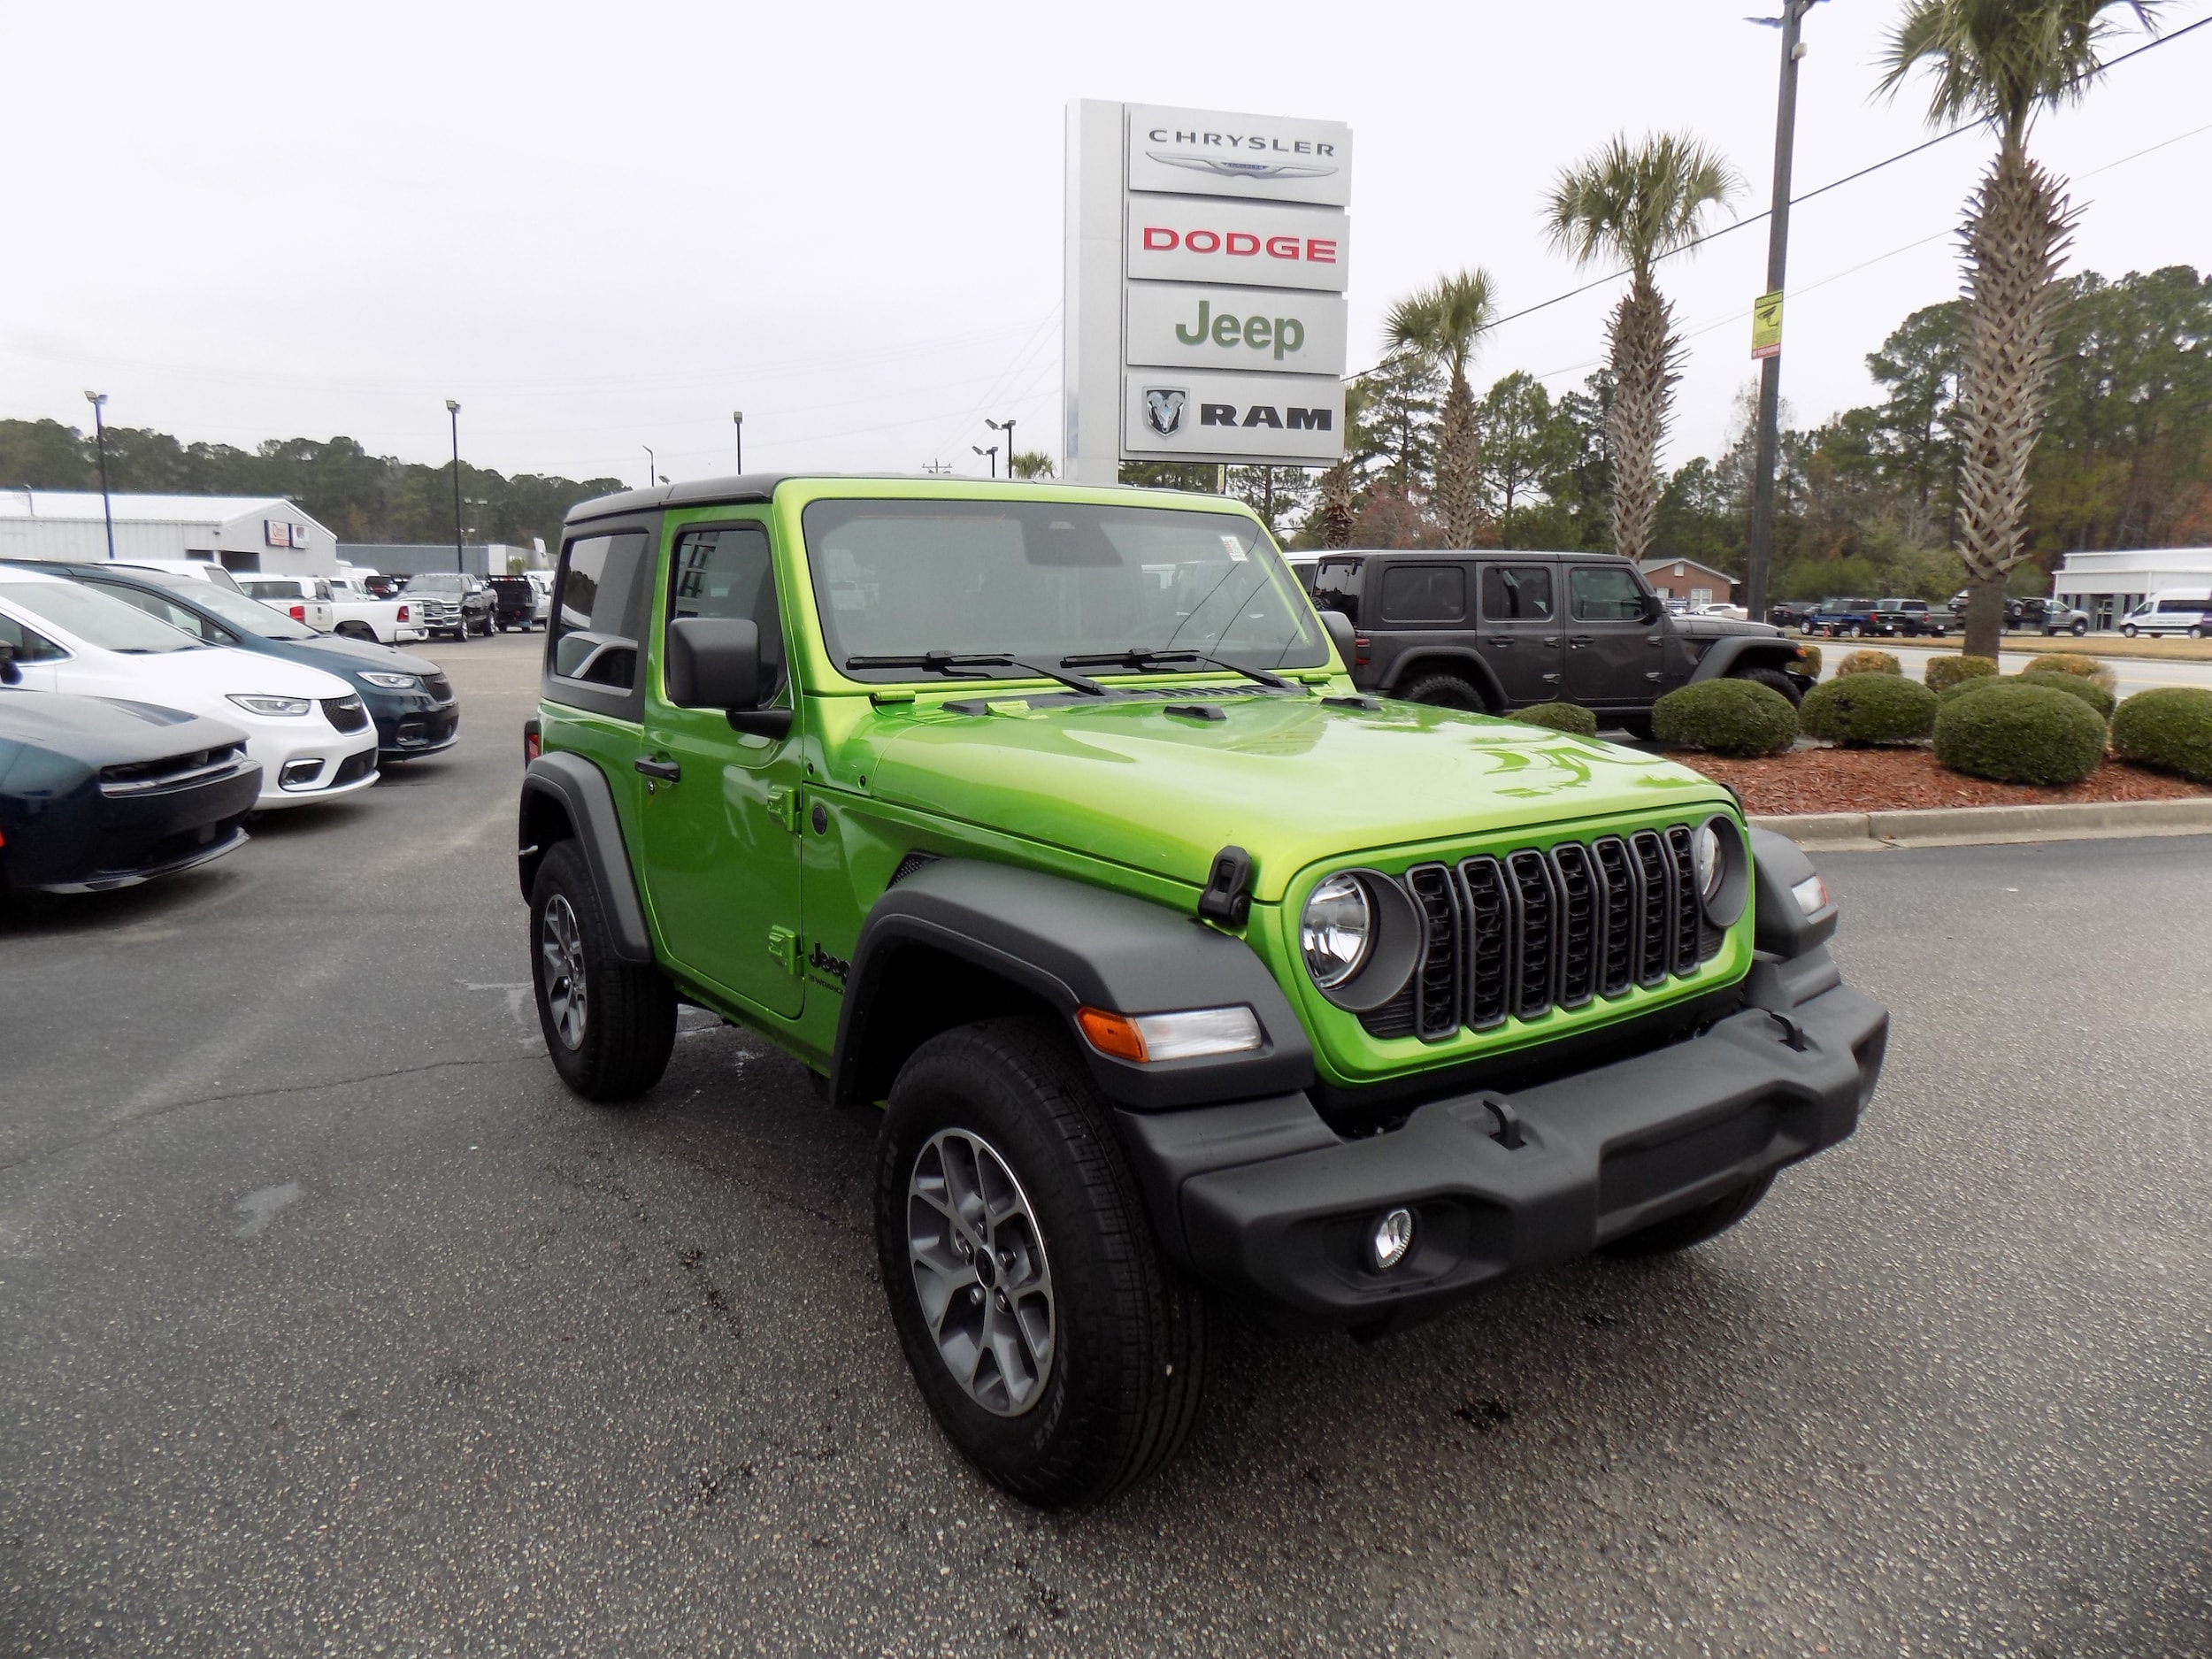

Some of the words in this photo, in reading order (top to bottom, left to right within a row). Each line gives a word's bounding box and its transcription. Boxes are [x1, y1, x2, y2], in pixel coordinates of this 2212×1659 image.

[1148, 129, 1334, 157] CHRYSLER
[1144, 227, 1337, 264] DODGE
[1176, 300, 1305, 360] Jeep
[1201, 403, 1333, 431] RAM
[809, 941, 850, 985] Jeep
